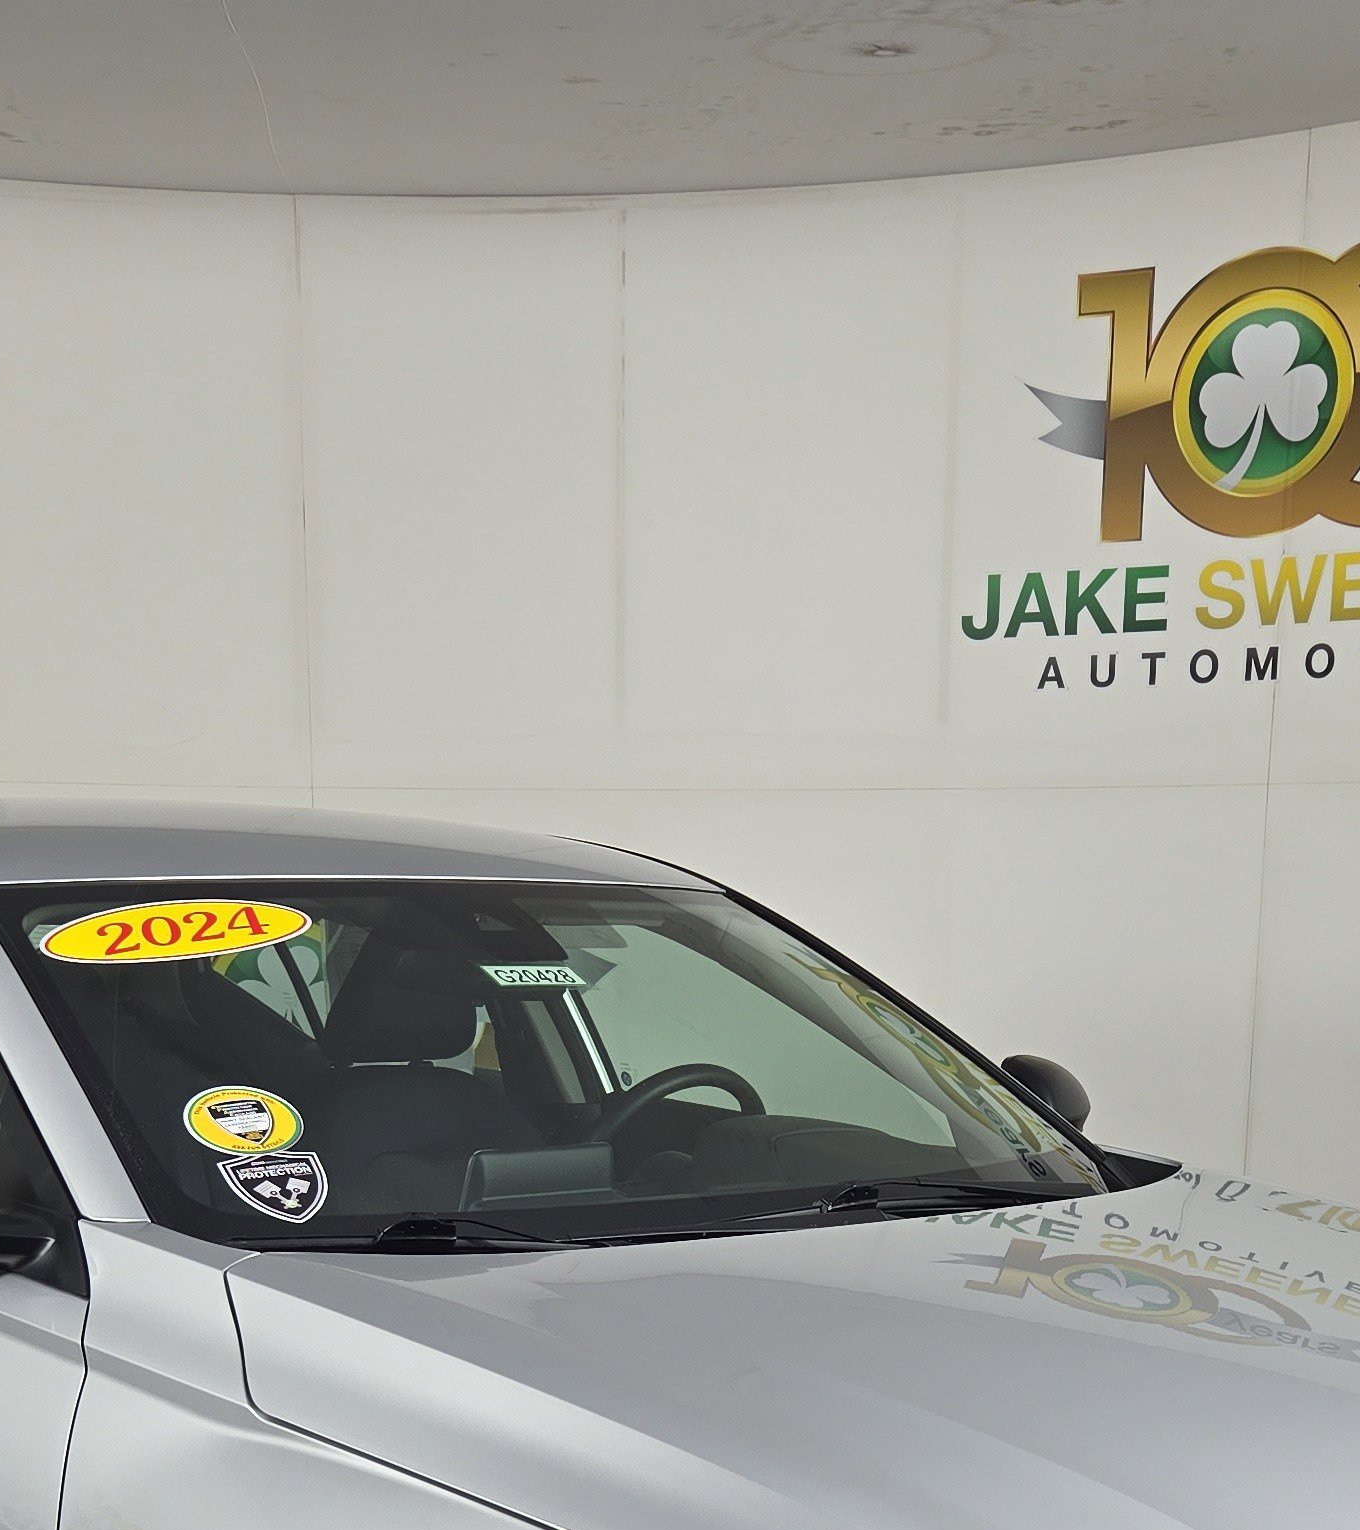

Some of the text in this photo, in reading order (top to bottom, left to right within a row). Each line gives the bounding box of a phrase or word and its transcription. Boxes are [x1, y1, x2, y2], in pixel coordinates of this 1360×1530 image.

[961, 564, 1170, 641] JAKE
[95, 906, 271, 957] 2024
[493, 968, 577, 984] G20428
[237, 1164, 313, 1181] PROTECTION
